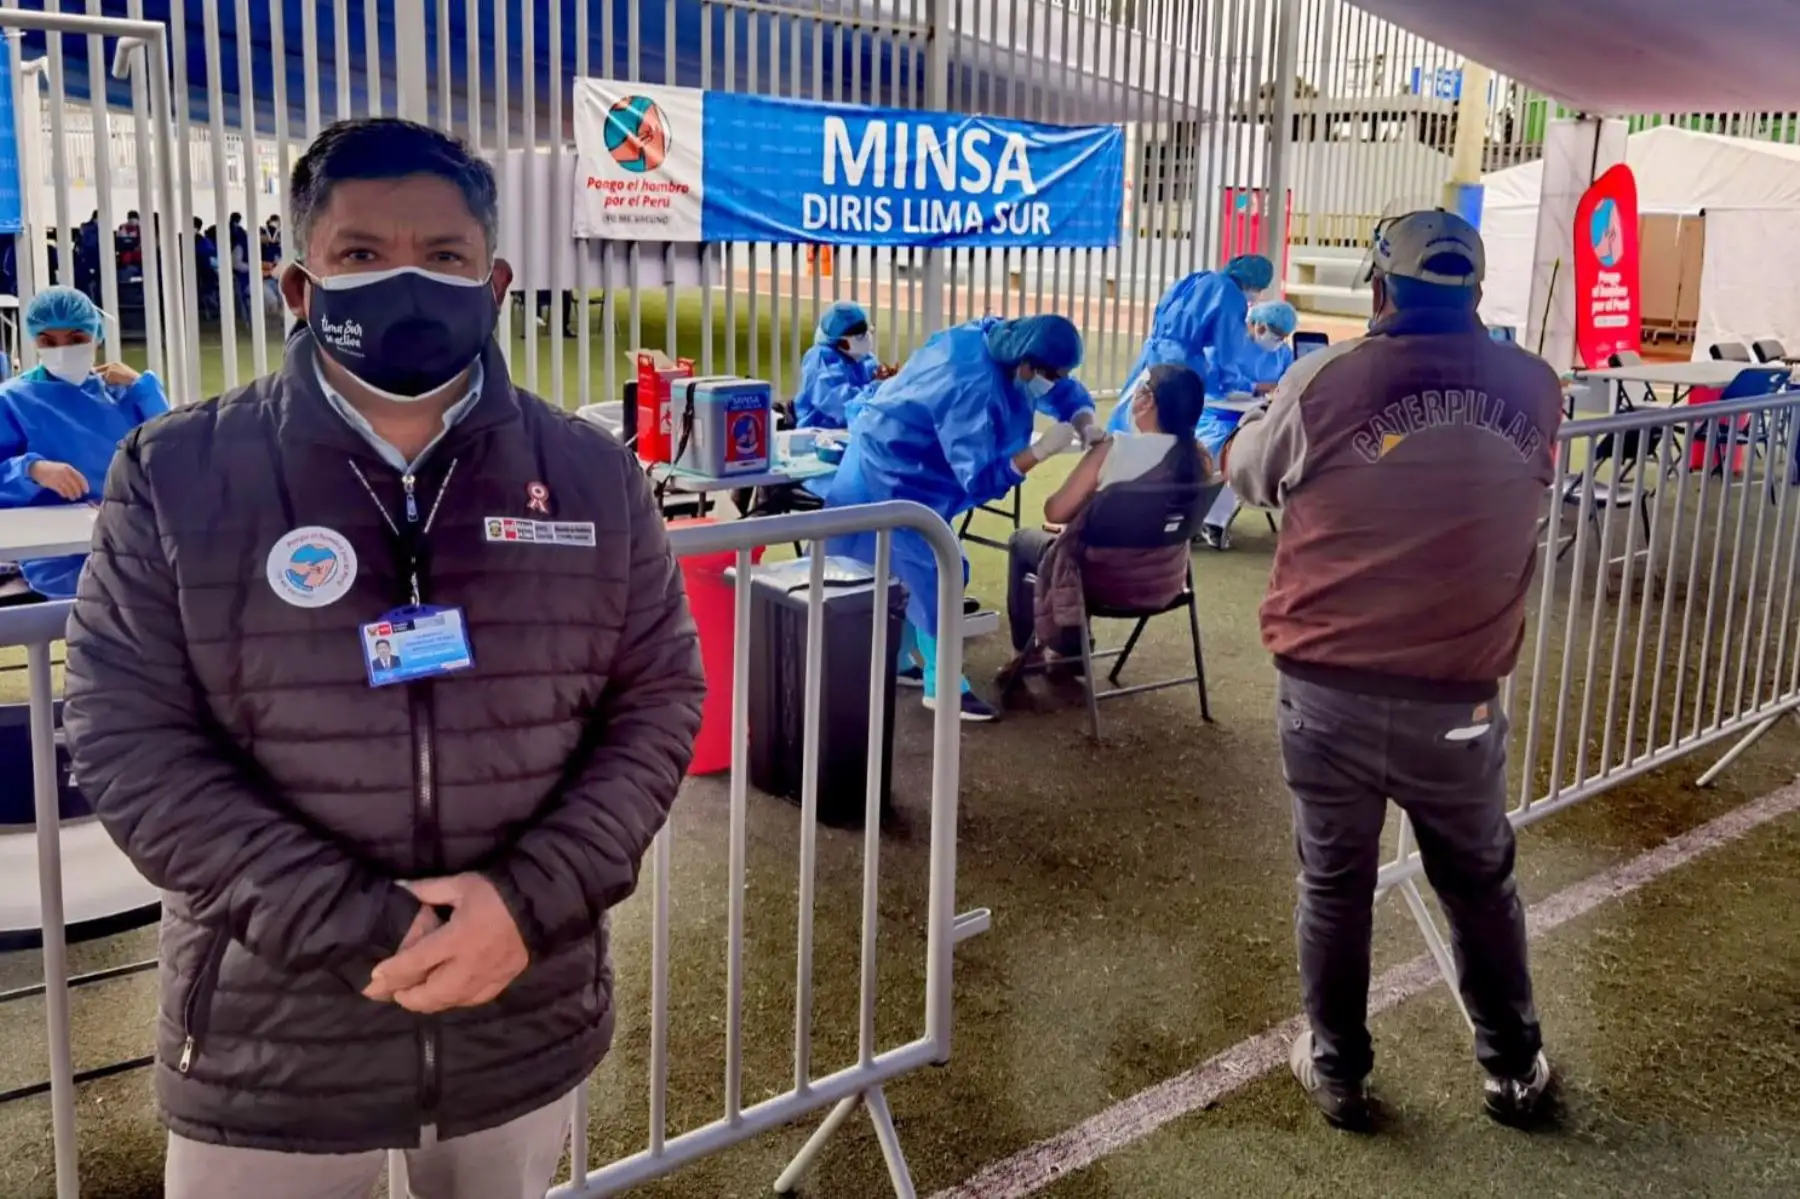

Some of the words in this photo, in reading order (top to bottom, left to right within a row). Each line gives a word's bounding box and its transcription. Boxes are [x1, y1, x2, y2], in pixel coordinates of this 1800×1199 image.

[822, 116, 1037, 195] MINSA
[587, 177, 625, 192] Pongo
[627, 179, 639, 191] el
[641, 179, 690, 194] hombro
[604, 196, 625, 208] por
[802, 193, 892, 233] DIRIS
[903, 198, 983, 234] LIMA
[990, 202, 1051, 235] SUR
[1352, 389, 1541, 464] CATERPILLAR
